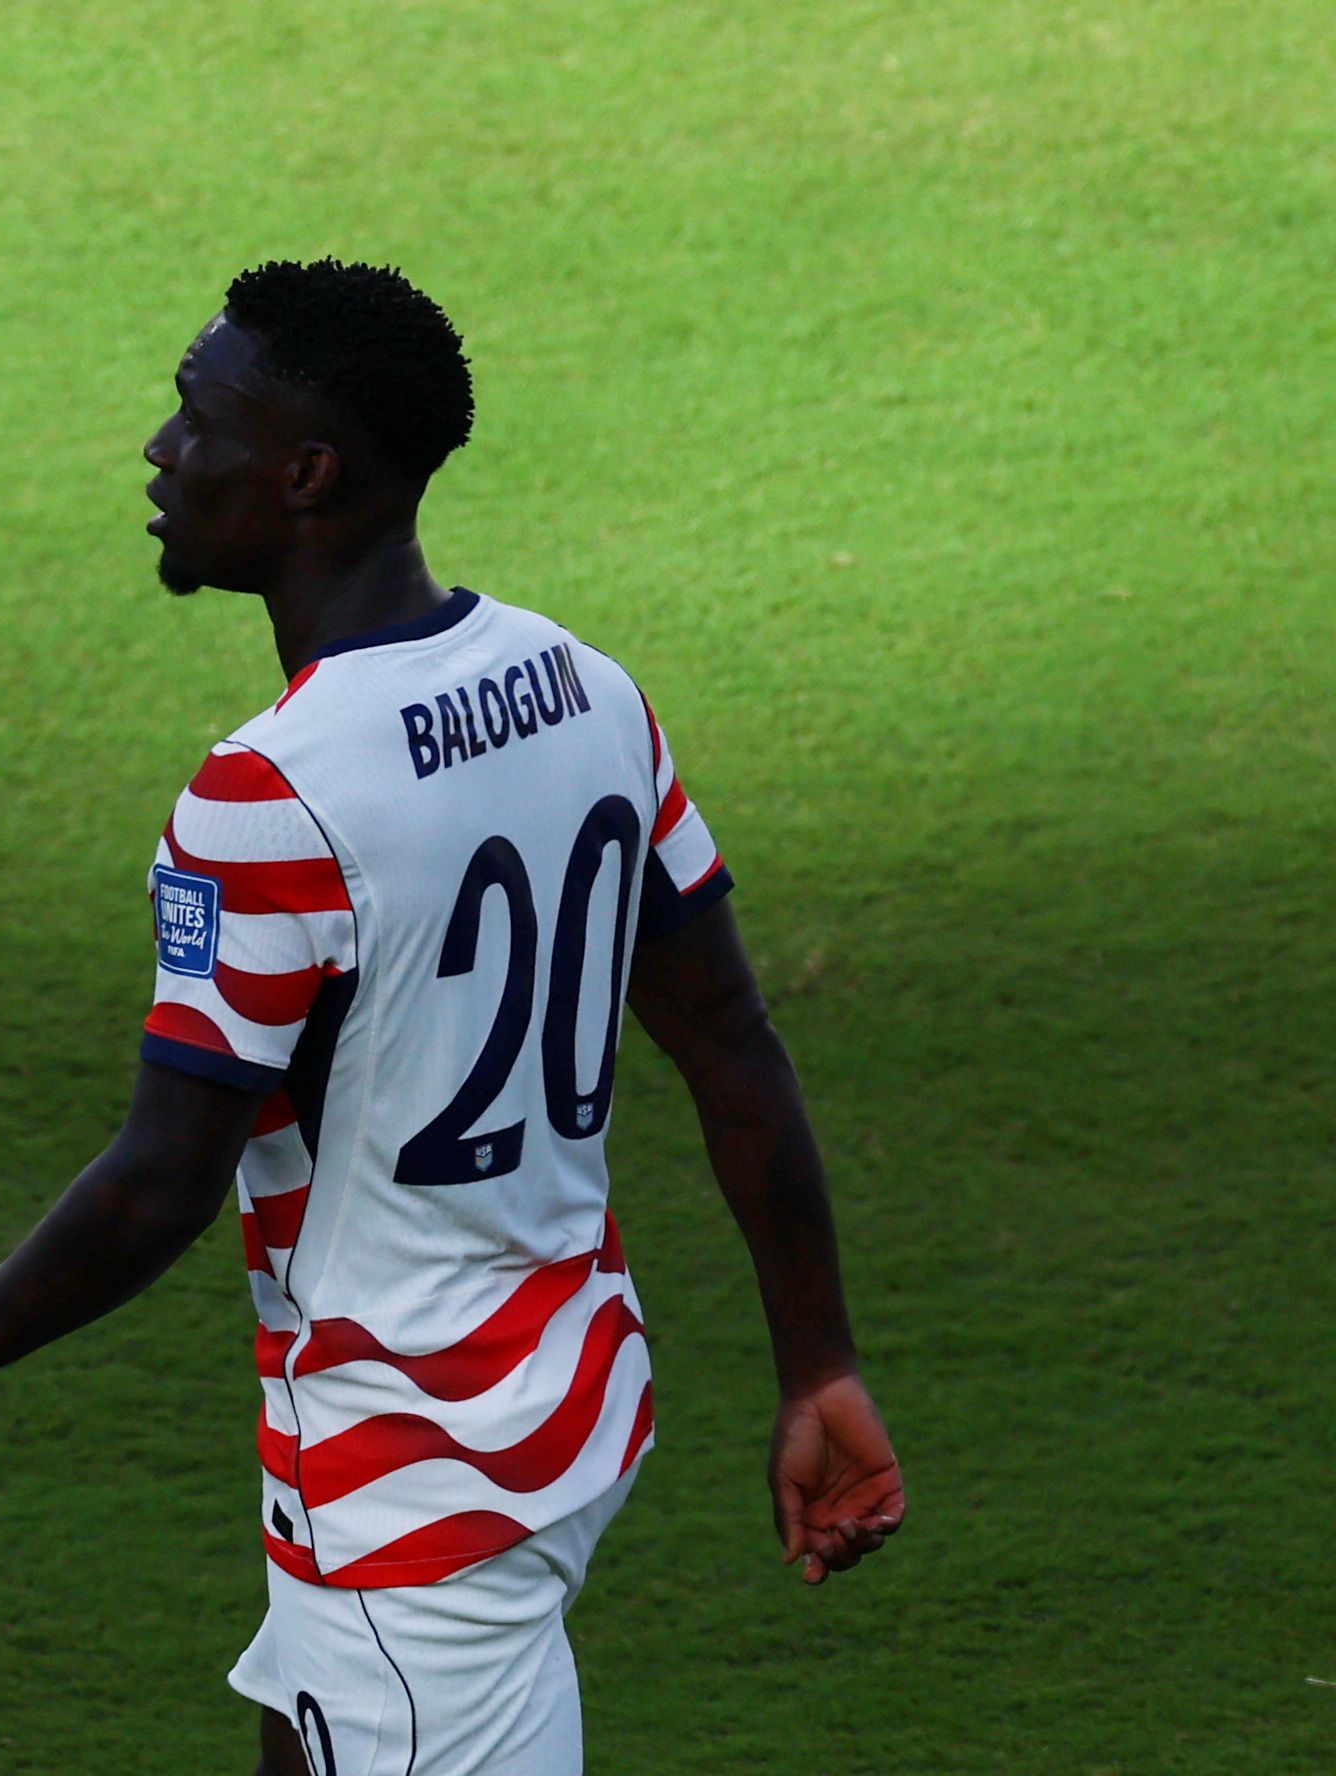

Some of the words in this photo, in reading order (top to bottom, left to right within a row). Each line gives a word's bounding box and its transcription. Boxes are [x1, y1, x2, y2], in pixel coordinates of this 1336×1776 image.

[400, 643, 592, 780] BALOGUN
[160, 883, 206, 907] FOOTBALL
[161, 900, 206, 929] UNITES
[171, 925, 207, 950] World
[167, 945, 186, 958] FIFA
[393, 794, 641, 1186] 20
